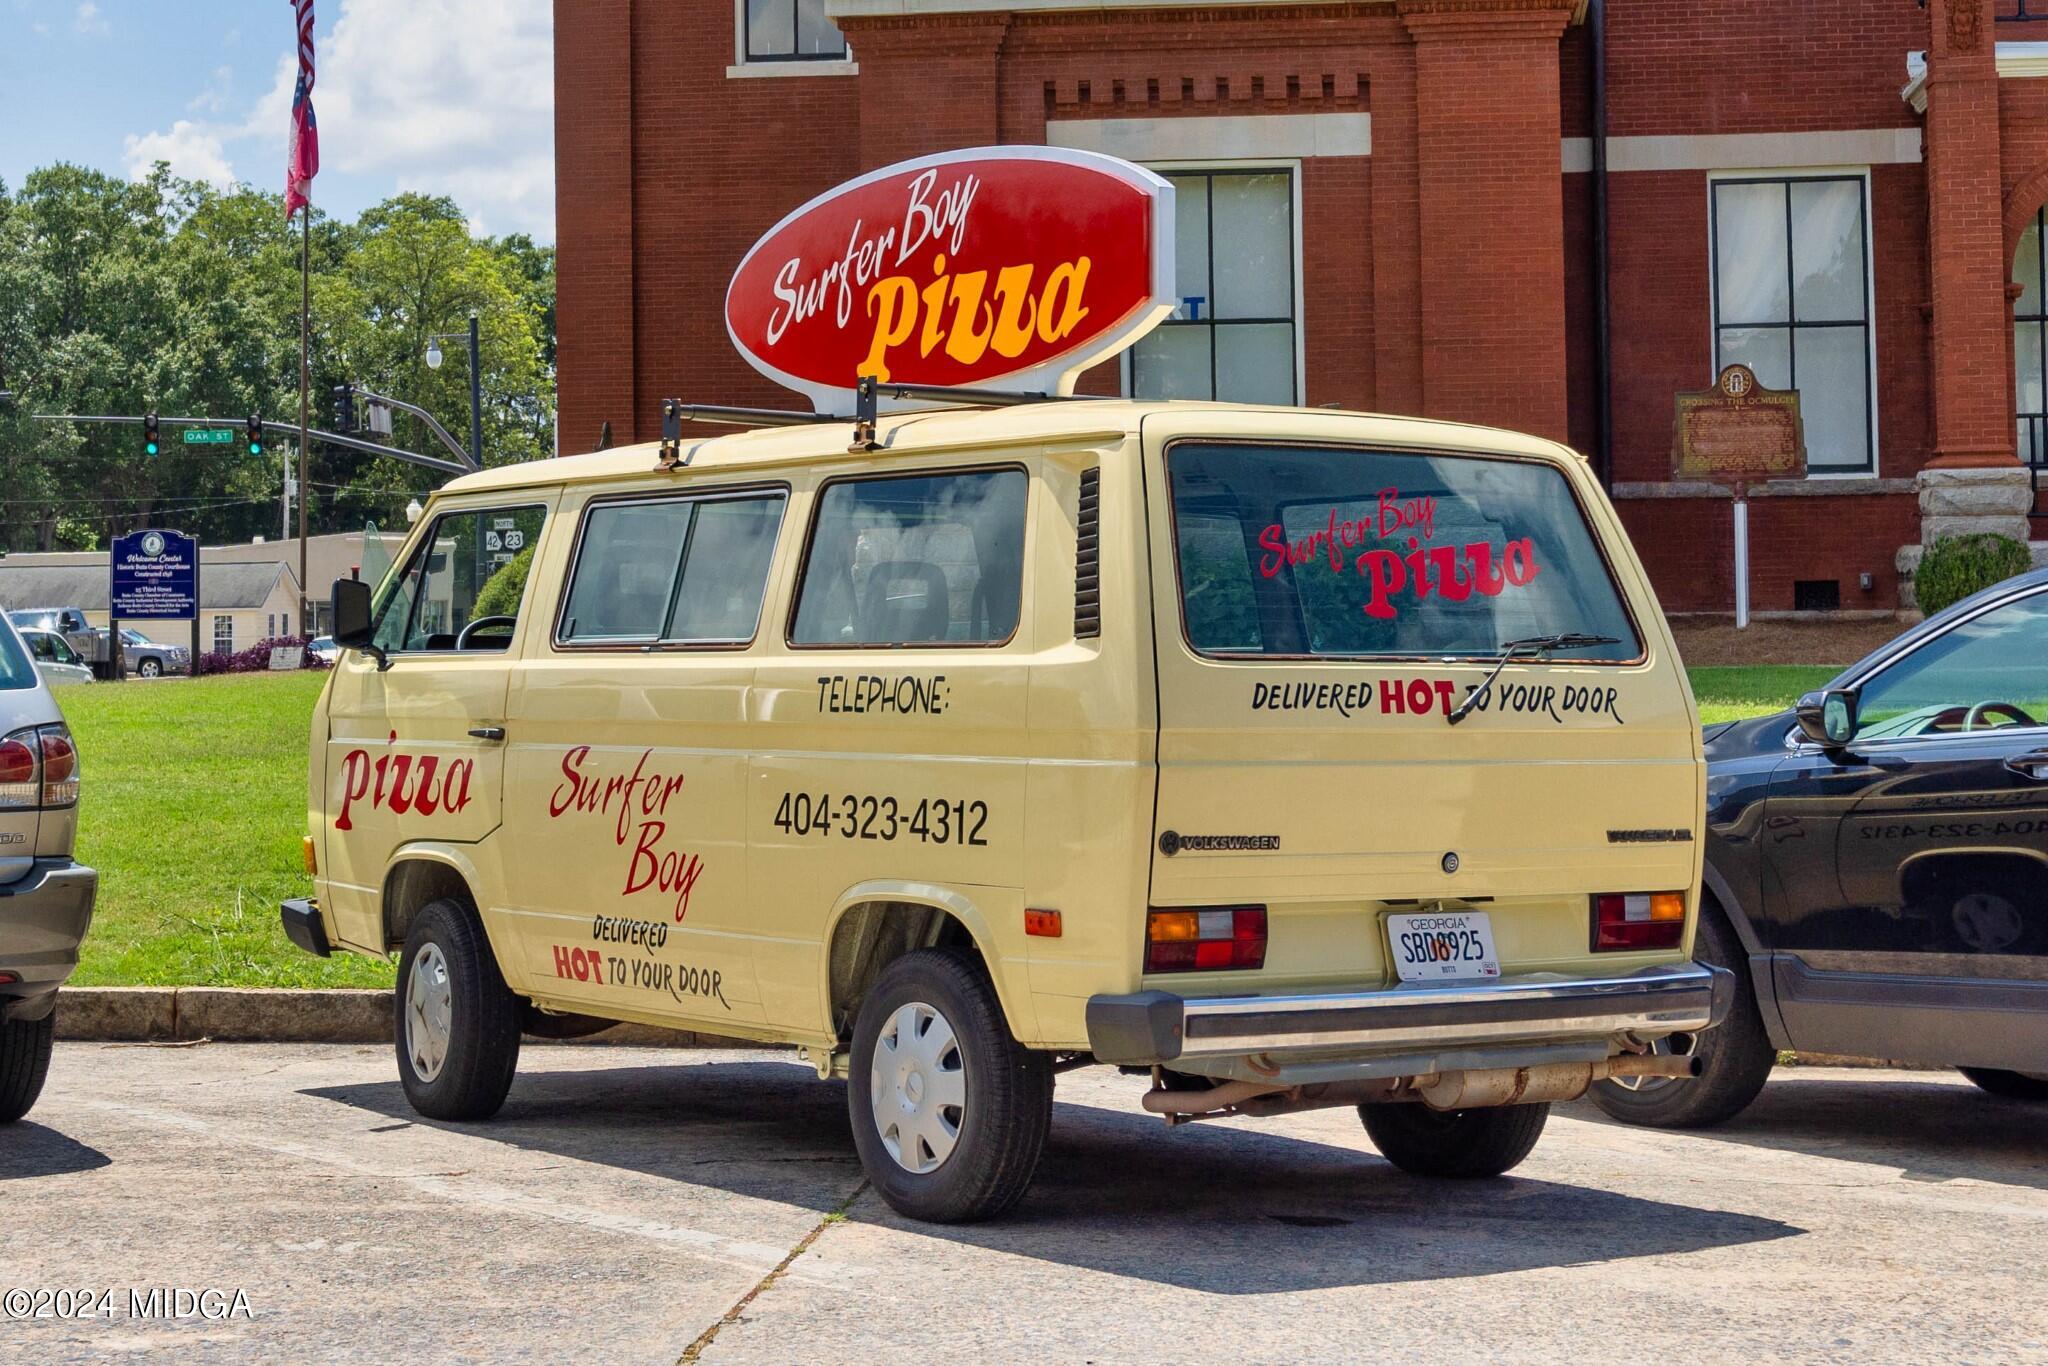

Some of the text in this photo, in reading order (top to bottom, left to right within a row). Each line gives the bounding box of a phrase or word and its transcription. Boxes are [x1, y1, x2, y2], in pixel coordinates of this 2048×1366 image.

[767, 168, 981, 346] Surfer Boy
[187, 432, 229, 441] OAK ST
[507, 534, 520, 546] 23
[1259, 487, 1436, 578] Surfer Boy
[127, 553, 182, 563] Welcome Center
[818, 676, 950, 714] TELEPHONE:
[1252, 682, 1372, 718] DELIVERED
[1379, 679, 1455, 715] HOT
[1500, 685, 1562, 723] YOUR
[1562, 686, 1624, 724] DOOR
[549, 745, 684, 846] Surfer
[774, 792, 988, 846] 404-323-4312
[1182, 835, 1280, 850] VOLKSWAGEN
[622, 821, 704, 923] Boy
[593, 914, 669, 956] DELIVERED
[1410, 917, 1467, 931] GEORGIA
[1401, 930, 1484, 963] SBD8925
[552, 944, 731, 1010] HOT TO YOUR DOOR
